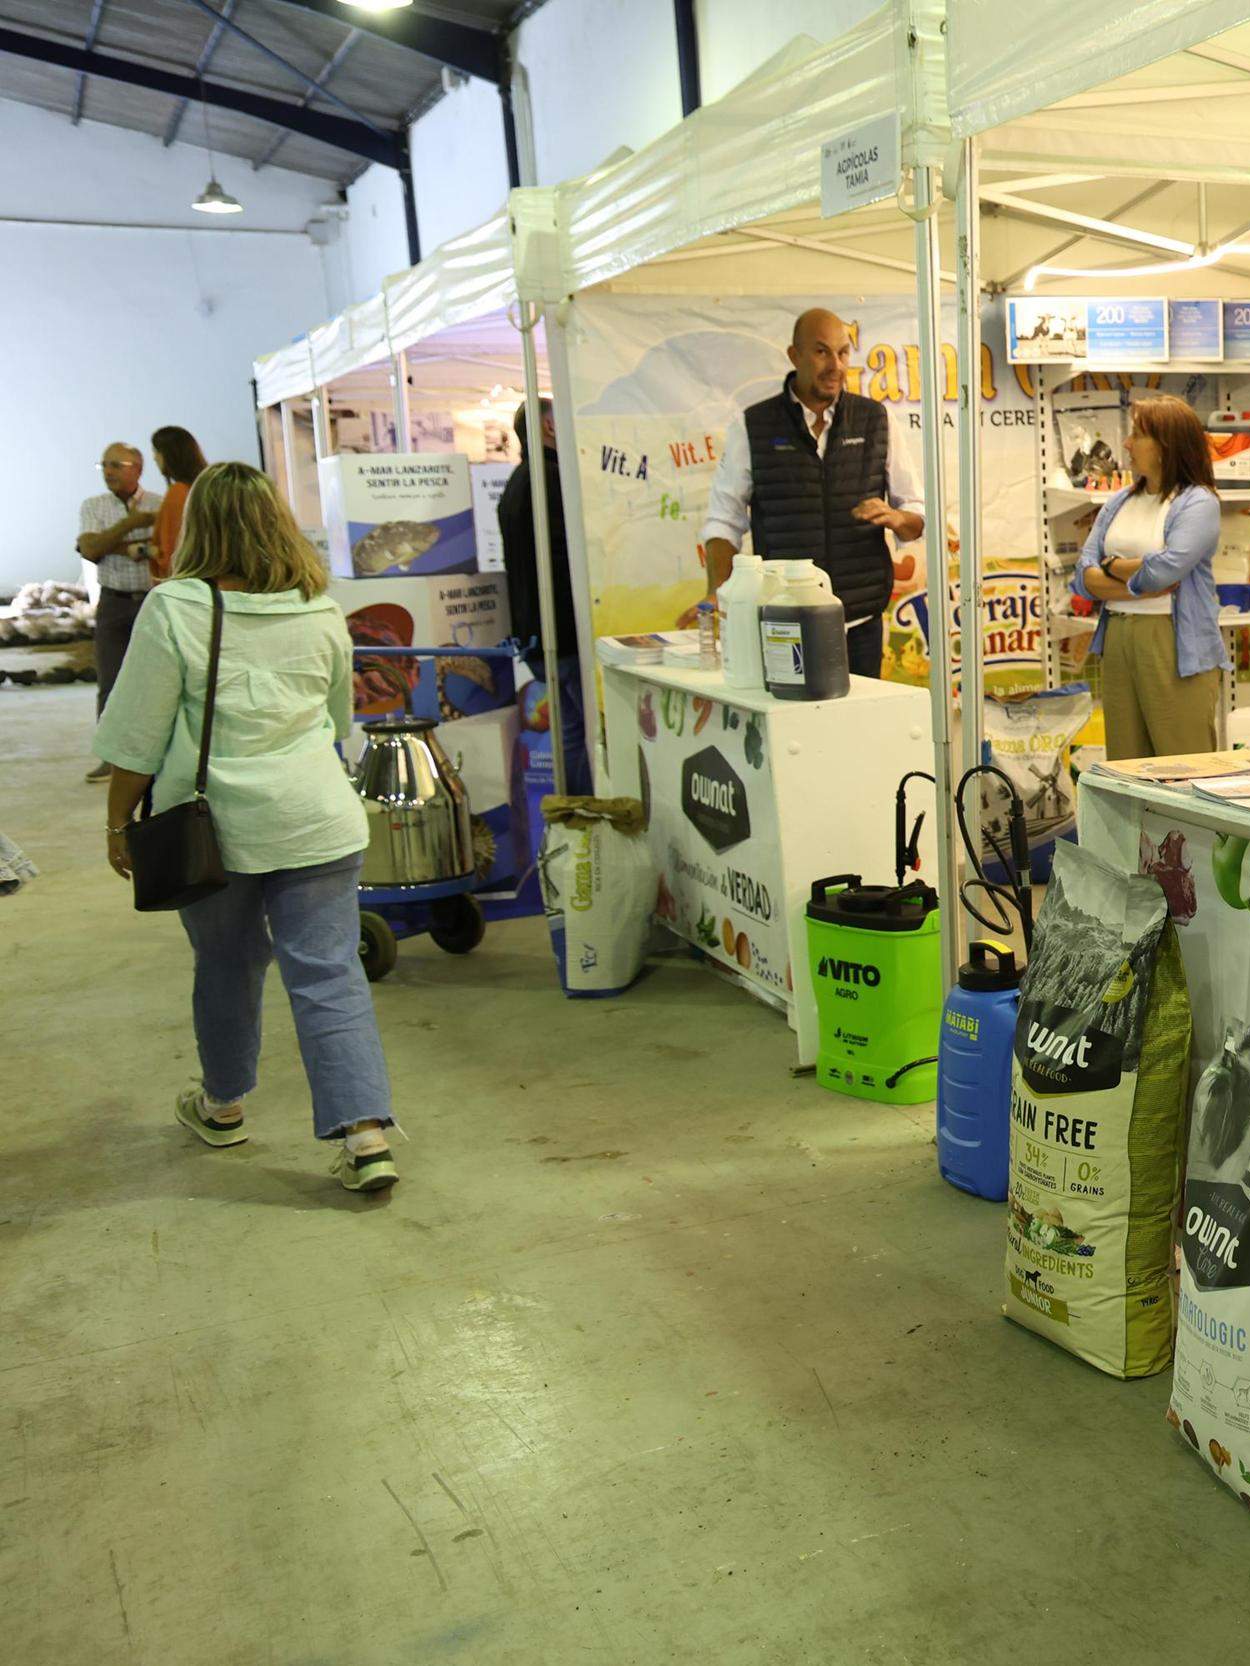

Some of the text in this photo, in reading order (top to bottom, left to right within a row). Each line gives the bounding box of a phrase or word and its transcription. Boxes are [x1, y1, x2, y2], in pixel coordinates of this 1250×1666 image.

[1096, 305, 1124, 325] 200
[600, 445, 648, 481] Vit. A
[669, 436, 716, 468] Vit. E
[404, 478, 416, 487] LA
[419, 478, 449, 487] PESCA
[659, 493, 687, 520] Fe.
[691, 772, 737, 817] ownat
[727, 866, 772, 922] VERDAD
[828, 957, 881, 988] VITO
[835, 987, 858, 1001] AGRO
[1027, 1021, 1092, 1068] wnat
[1044, 1110, 1098, 1150] FREE
[1026, 1142, 1048, 1168] 34%
[1078, 1162, 1101, 1181] 0%
[1070, 1183, 1104, 1196] GRAINS
[1022, 1243, 1094, 1279] INGREDIENTS
[1038, 1281, 1054, 1294] FOOD
